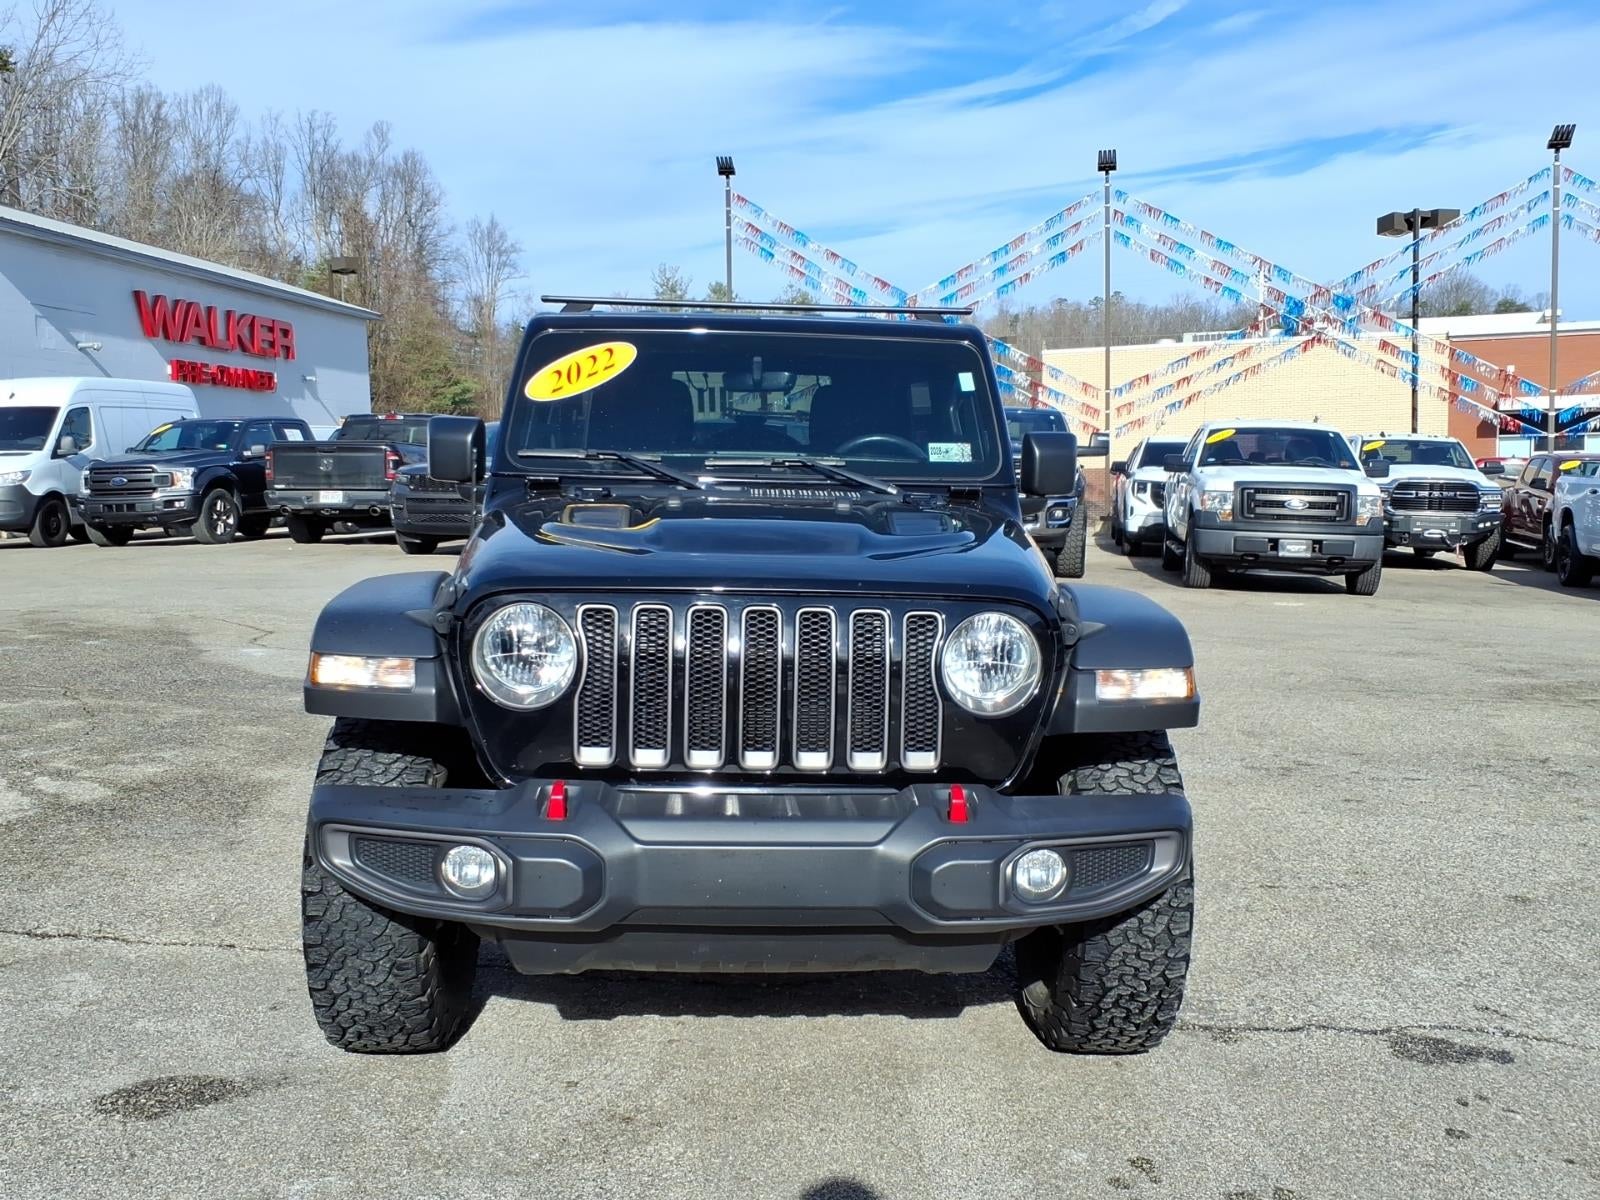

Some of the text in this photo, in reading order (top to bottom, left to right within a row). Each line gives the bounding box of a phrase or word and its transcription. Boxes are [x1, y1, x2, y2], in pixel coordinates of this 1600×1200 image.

[133, 290, 296, 360] WALKER
[170, 359, 276, 392] PRE-OWNED
[551, 347, 615, 394] 2022
